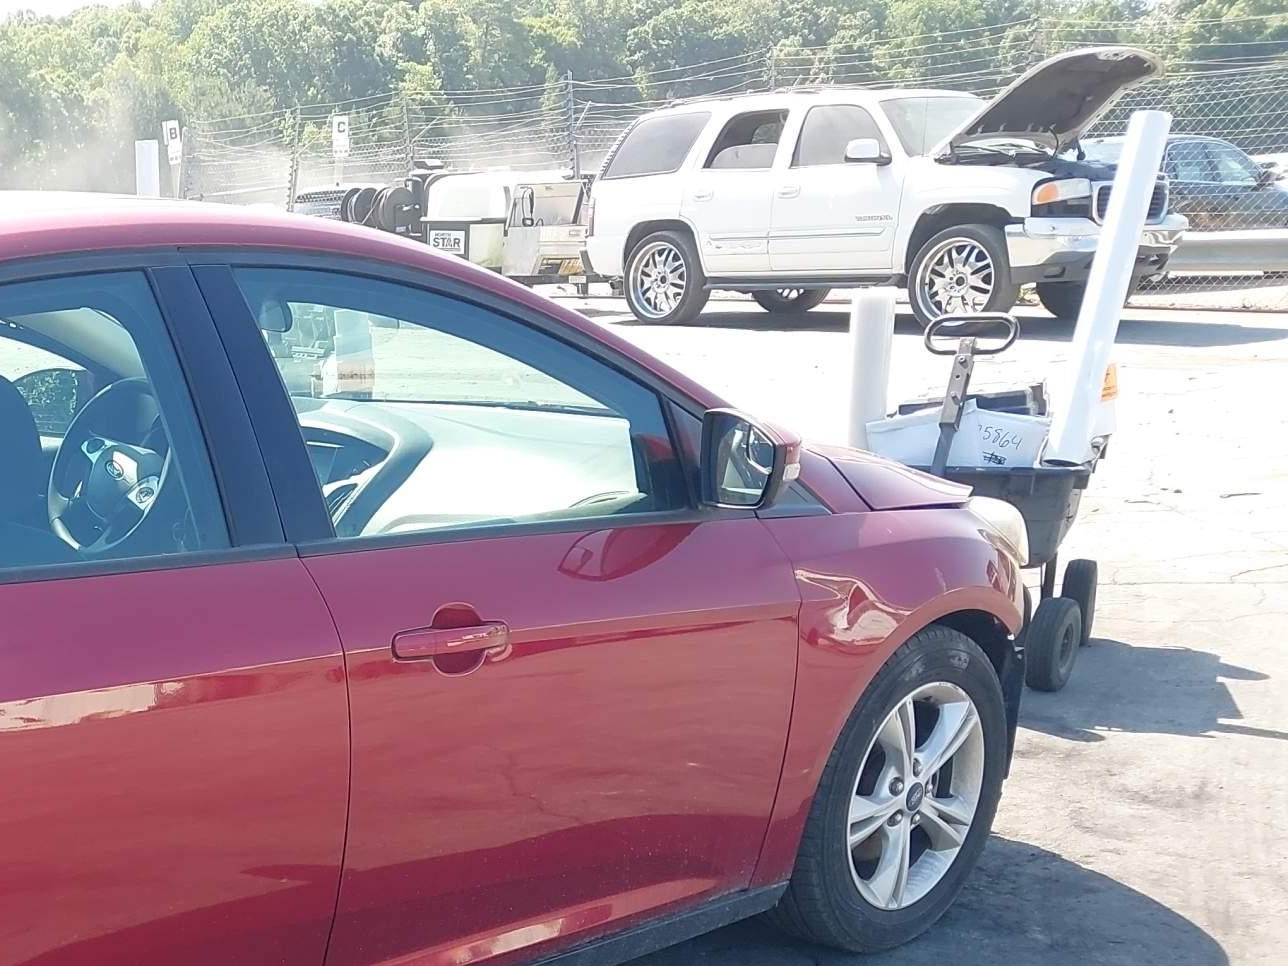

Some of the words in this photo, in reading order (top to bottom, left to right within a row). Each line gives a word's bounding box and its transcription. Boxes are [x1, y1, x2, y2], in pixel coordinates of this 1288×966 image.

[337, 121, 346, 133] C
[169, 127, 178, 140] B
[432, 237, 461, 248] STAR
